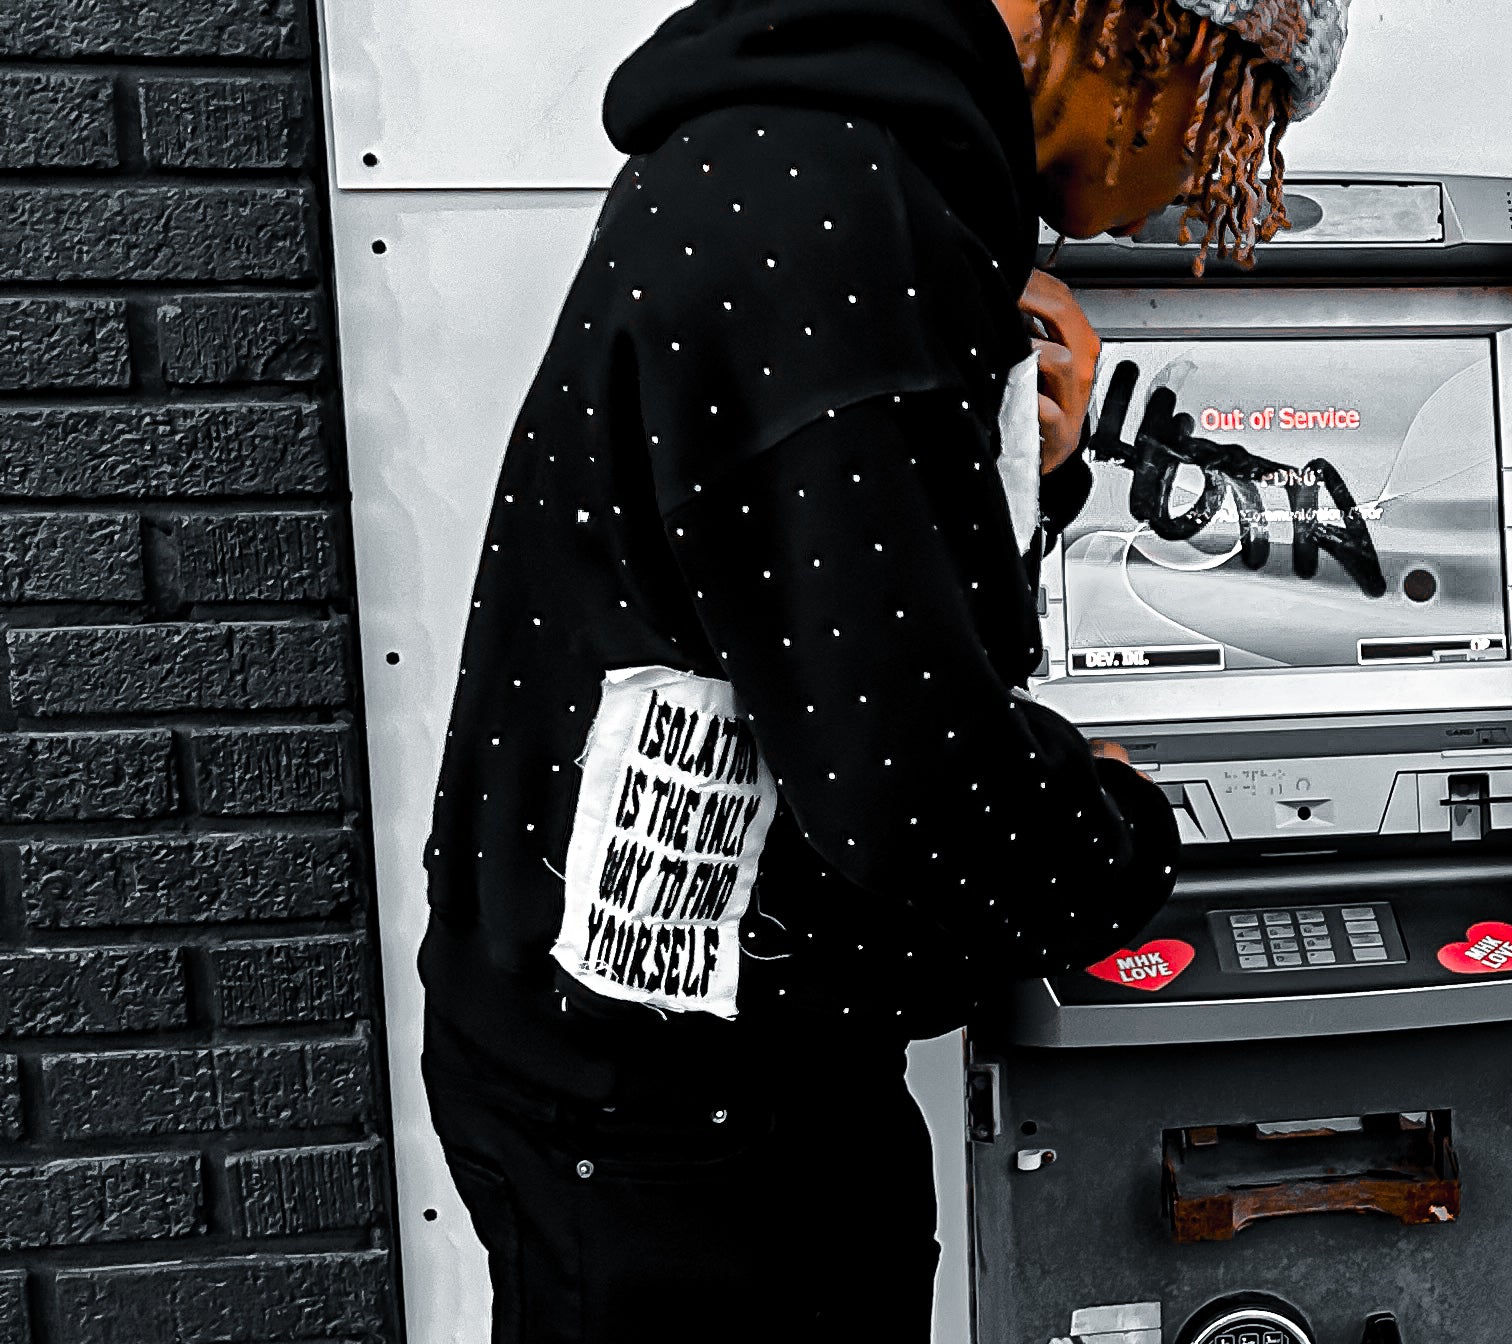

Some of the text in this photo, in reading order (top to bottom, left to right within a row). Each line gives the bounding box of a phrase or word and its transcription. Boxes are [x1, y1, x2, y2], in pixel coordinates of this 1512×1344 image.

[1201, 407, 1360, 431] Out of Service
[616, 765, 761, 858] IS THE ONLY
[599, 836, 740, 922] WAY TO FIND
[584, 902, 720, 998] YOURSELF
[1464, 935, 1504, 961] MHK
[1116, 952, 1164, 971] MHK
[1119, 963, 1173, 982] LOVE
